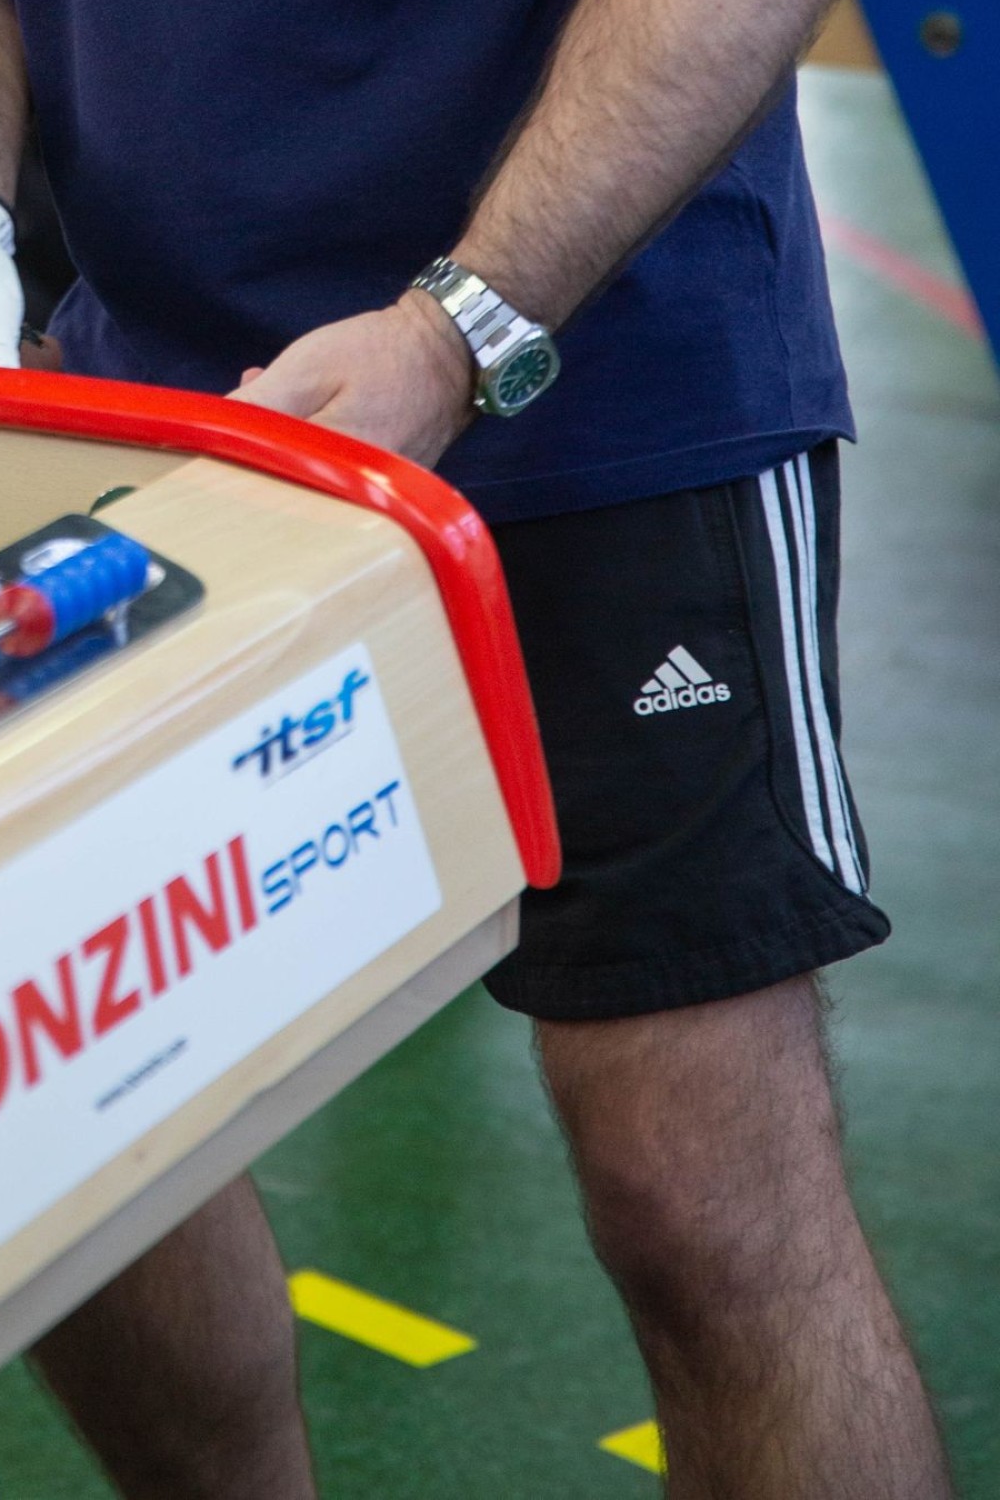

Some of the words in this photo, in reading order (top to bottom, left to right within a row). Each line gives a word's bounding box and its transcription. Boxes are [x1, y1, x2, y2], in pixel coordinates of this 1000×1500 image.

[232, 668, 370, 777] itsf
[633, 683, 731, 716] adidas
[260, 779, 400, 916] SPORT
